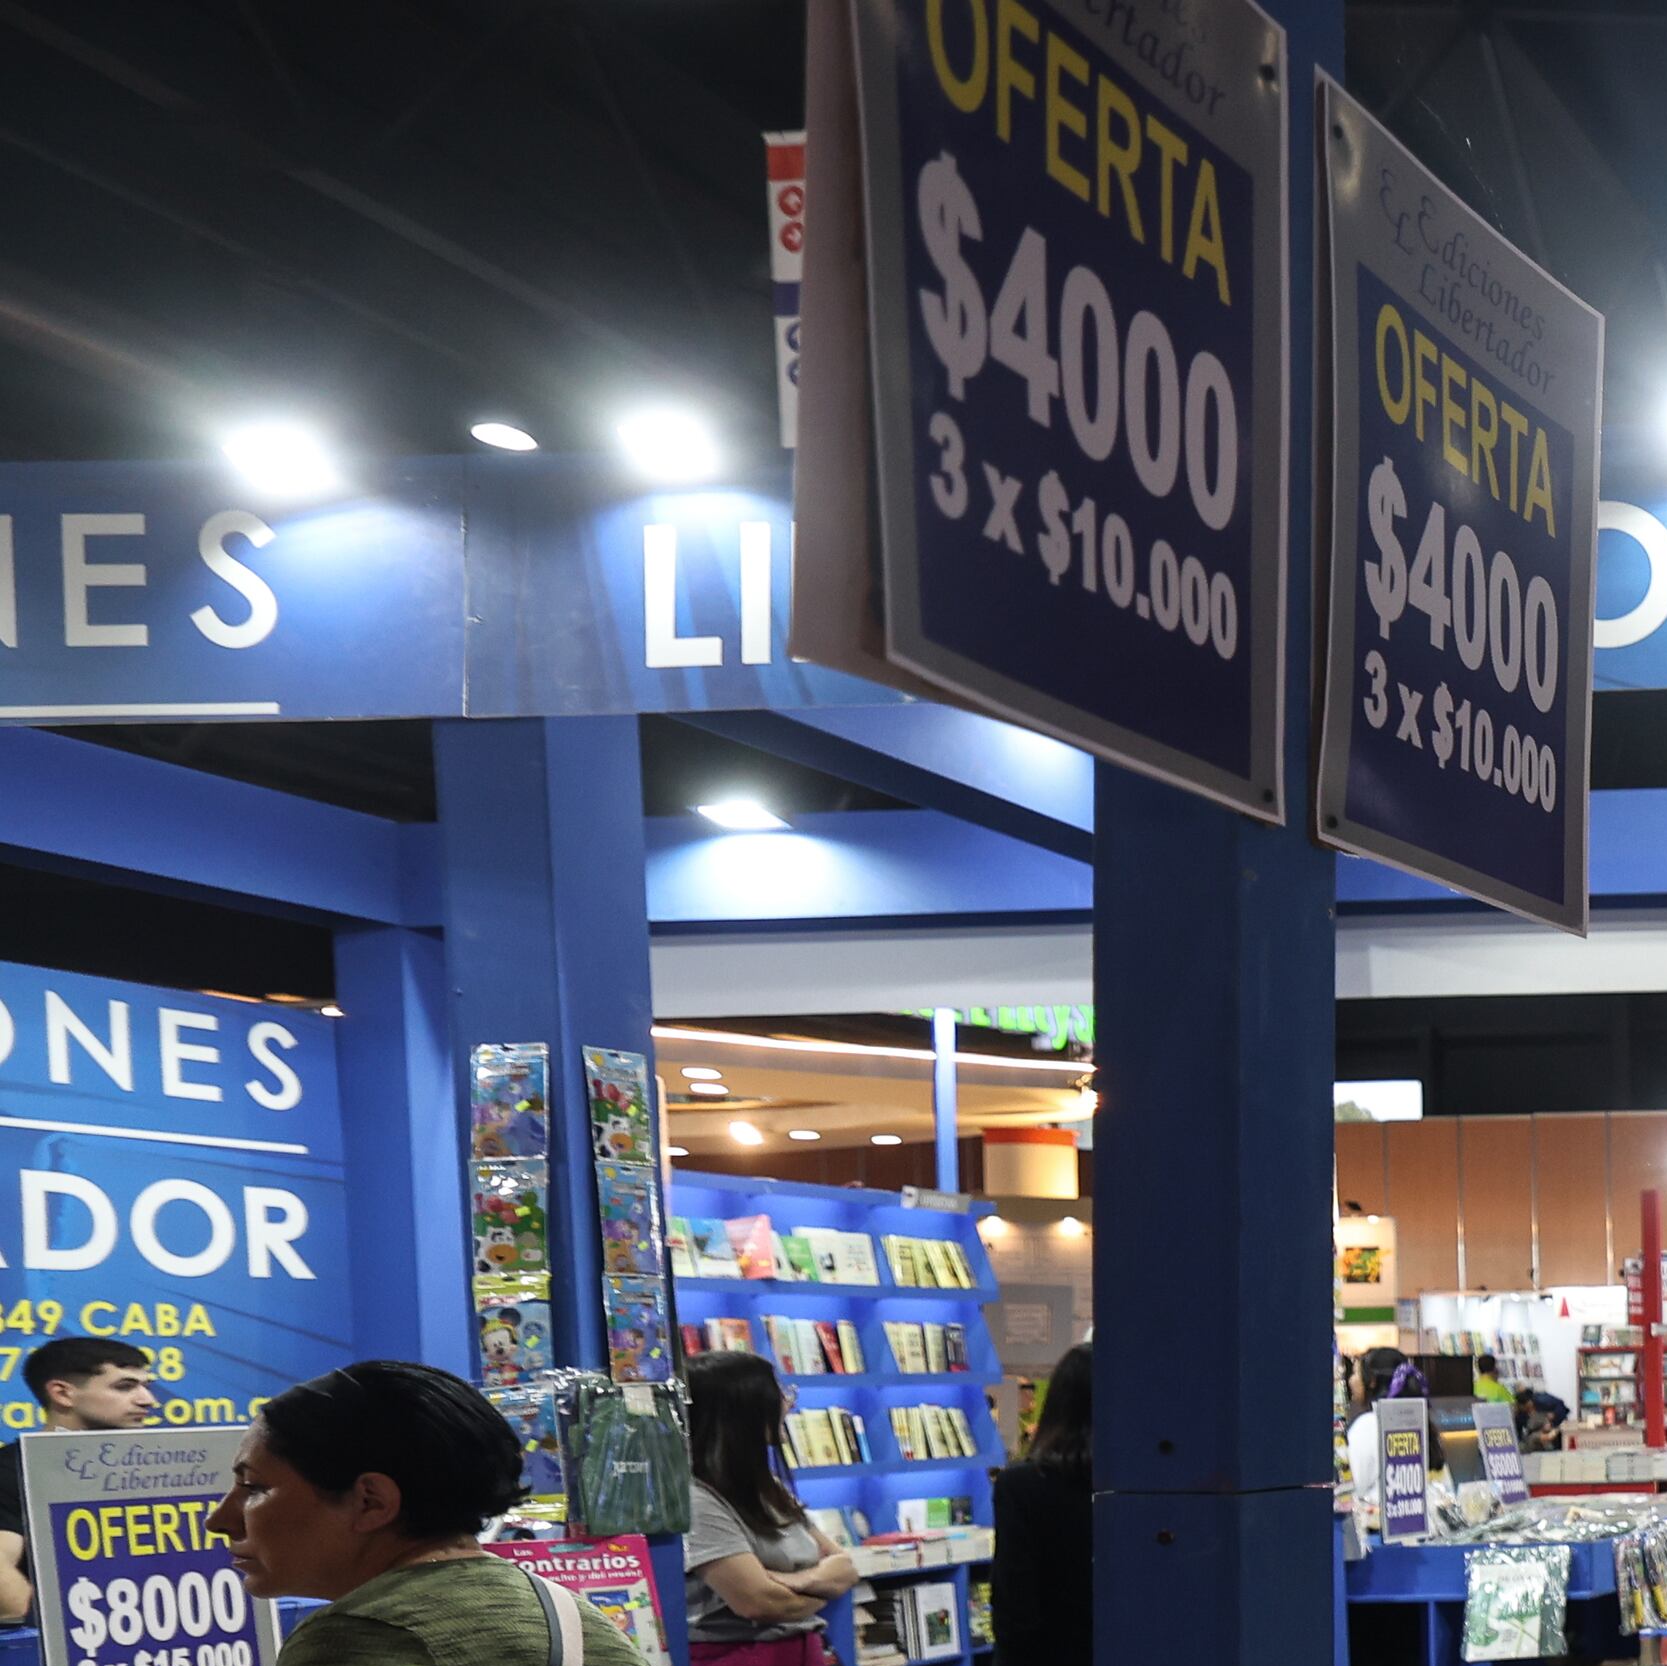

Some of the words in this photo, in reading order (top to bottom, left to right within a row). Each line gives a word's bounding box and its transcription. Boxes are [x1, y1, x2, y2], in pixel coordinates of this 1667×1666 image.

[924, 0, 1233, 307] OFERTA
[1417, 191, 1547, 342] Ediciones
[1418, 263, 1557, 398] Libertador
[917, 148, 1240, 531] $4000
[1375, 302, 1558, 540] OFERTA
[0, 510, 280, 649] ES
[643, 521, 806, 669] LI
[928, 412, 967, 520] 3
[983, 461, 1025, 556] x
[1038, 467, 1238, 660] $10.000
[1364, 454, 1560, 715] $4000
[1363, 651, 1389, 730] 3
[1397, 684, 1422, 749] x
[1432, 682, 1557, 814] $10.000
[0, 1169, 317, 1281] DOR
[0, 1299, 64, 1337] 49
[80, 1300, 217, 1337] CABA
[99, 1442, 208, 1467] Ediciones
[102, 1470, 220, 1494] Libertador
[1386, 1432, 1420, 1457] OFERTA
[1386, 1463, 1423, 1500] $4000
[68, 1568, 247, 1658] $8000
[510, 1553, 641, 1574] ontrarios
